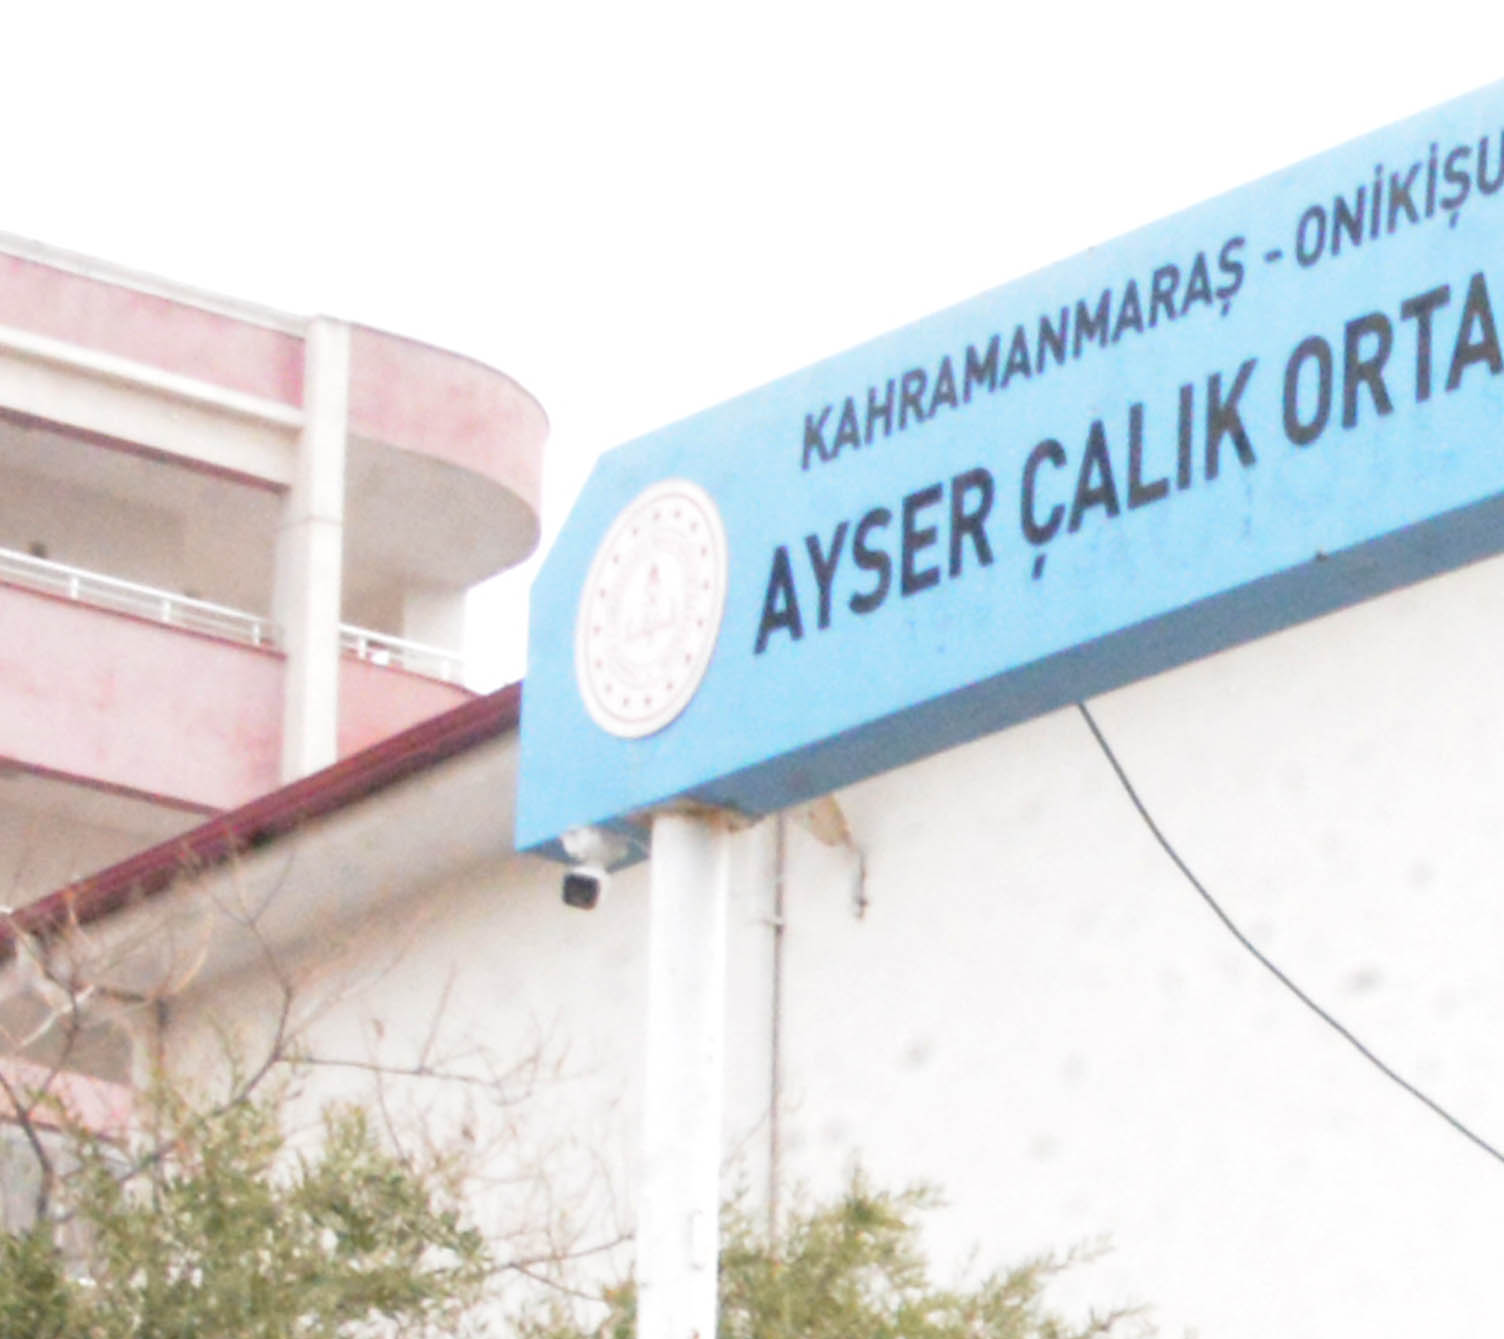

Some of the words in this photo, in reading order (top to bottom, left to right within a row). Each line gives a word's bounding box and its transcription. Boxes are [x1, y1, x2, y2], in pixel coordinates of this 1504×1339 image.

[801, 235, 1246, 471] KAHRAMANMARAŞ
[753, 467, 995, 655] AYSER
[1020, 357, 1259, 581] ÇALIK
